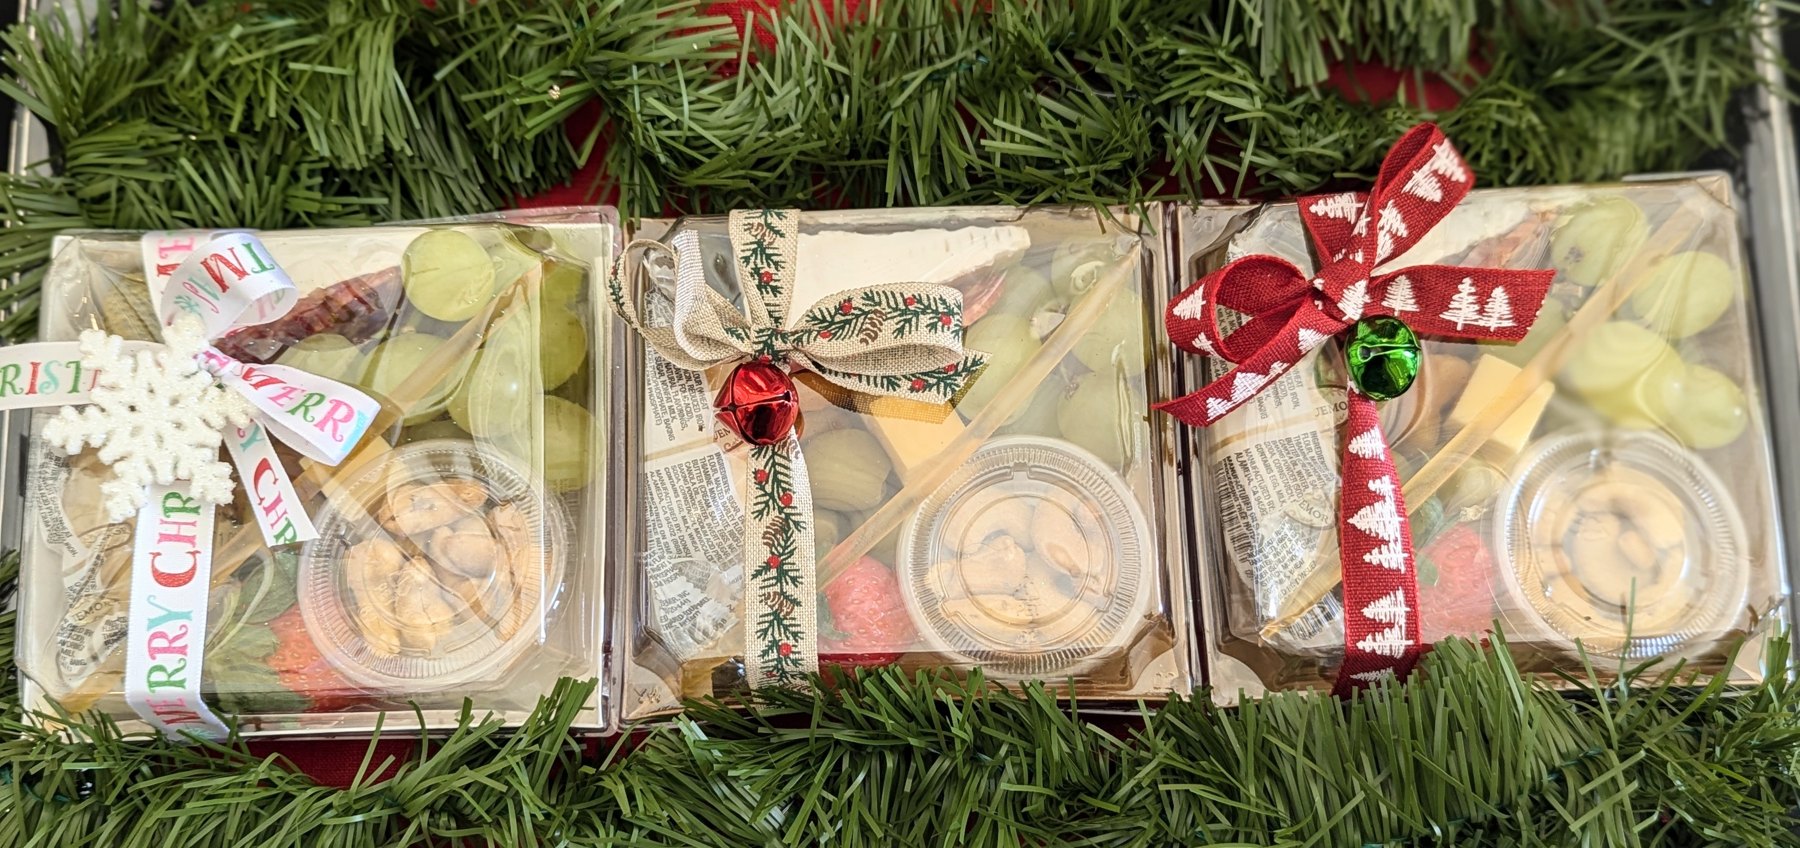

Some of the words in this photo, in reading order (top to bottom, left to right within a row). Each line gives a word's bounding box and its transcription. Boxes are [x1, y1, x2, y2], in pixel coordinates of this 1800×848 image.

[0, 360, 102, 397] RIST
[652, 356, 665, 379] SUGAR,
[659, 379, 673, 403] NONFAT
[663, 361, 677, 390] NATURAL
[687, 383, 700, 412] REDUCED
[1256, 396, 1268, 419] BAKING
[1289, 391, 1300, 409] IRON,
[663, 418, 675, 441] BAKING
[1285, 436, 1300, 458] BUTTER
[691, 458, 703, 483] BUTTER
[698, 456, 713, 487] THIAMINE
[714, 451, 730, 494] INGREDIENTS:
[1225, 455, 1253, 512] MANUFACTURED
[1243, 448, 1270, 501] MANUFACTURED
[1266, 500, 1275, 511] BY:
[1254, 443, 1273, 474] CONTAINS
[1269, 474, 1279, 490] EGG,
[1281, 459, 1296, 483] POWDER
[1295, 469, 1309, 492] WATER,
[648, 470, 665, 504] ALAMEDA,
[660, 505, 668, 515] CA
[664, 515, 676, 537] 94502
[654, 468, 677, 521] MANUFACTURED
[674, 522, 682, 533] BY:
[677, 462, 688, 485] BAKING
[685, 485, 698, 512] POWDER
[704, 537, 715, 550] ACID
[684, 461, 696, 486] CANOLA
[705, 522, 719, 541] INVERT
[706, 454, 719, 476] FLOUR,
[713, 476, 724, 499] MALTED
[720, 500, 735, 522] BARLEY
[1250, 485, 1258, 495] CA
[663, 466, 679, 498] CONTAINS
[675, 499, 685, 515] EGG,
[687, 531, 700, 553] WHEAT
[659, 529, 667, 540] ON
[146, 594, 206, 726] MERRY
